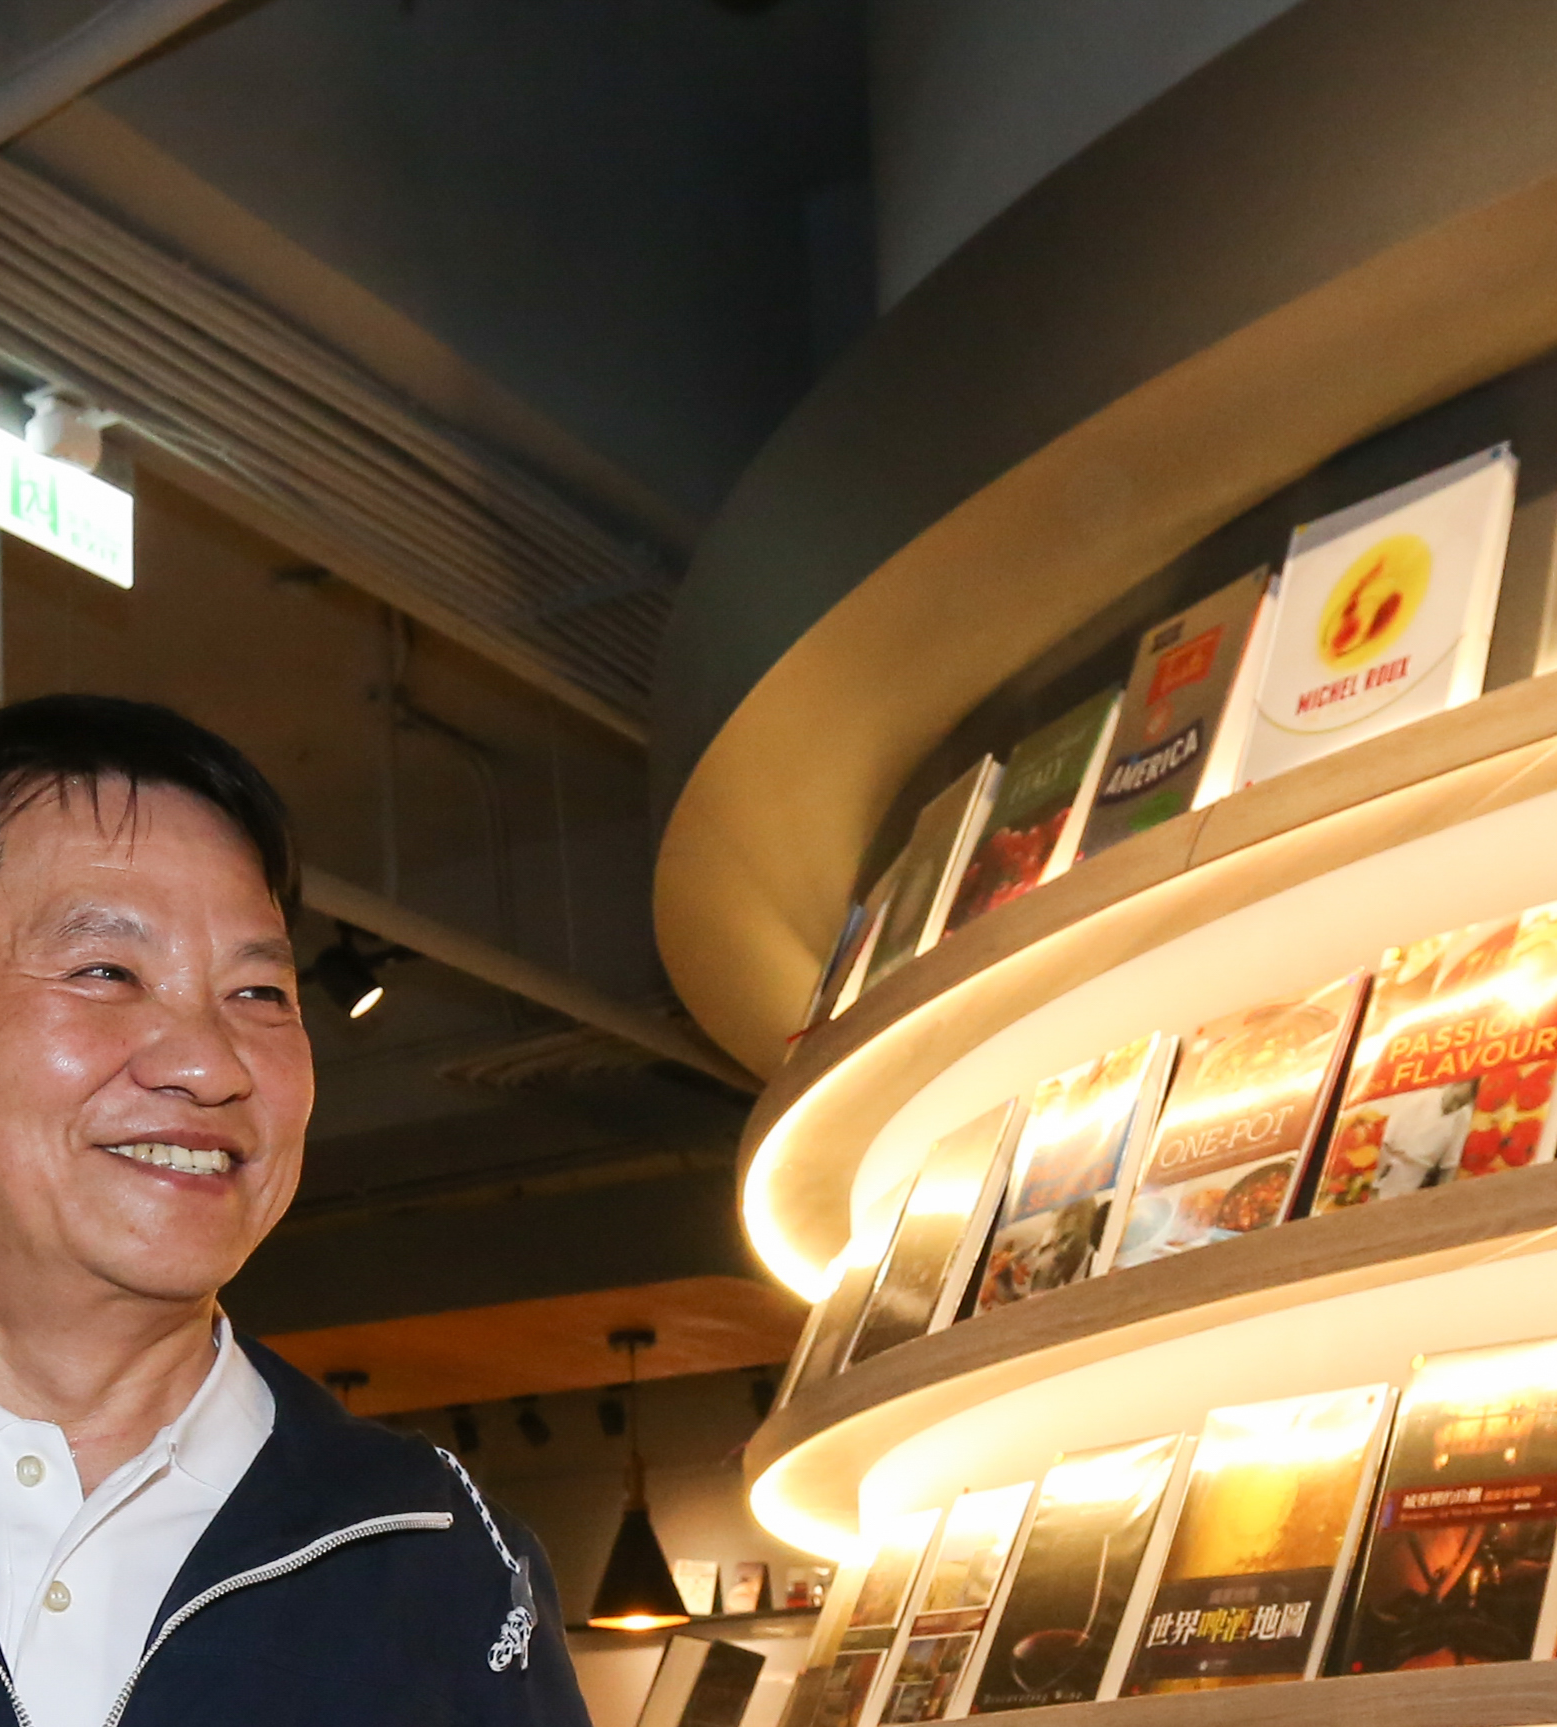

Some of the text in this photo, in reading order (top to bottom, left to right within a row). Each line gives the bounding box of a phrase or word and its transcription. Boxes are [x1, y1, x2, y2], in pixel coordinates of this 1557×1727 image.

[1295, 655, 1411, 716] MICHEL ROUX
[1104, 728, 1198, 795] AMERICA
[1159, 1106, 1294, 1168] ONE-POT
[1146, 1601, 1311, 1648] 世界啤酒地圖
